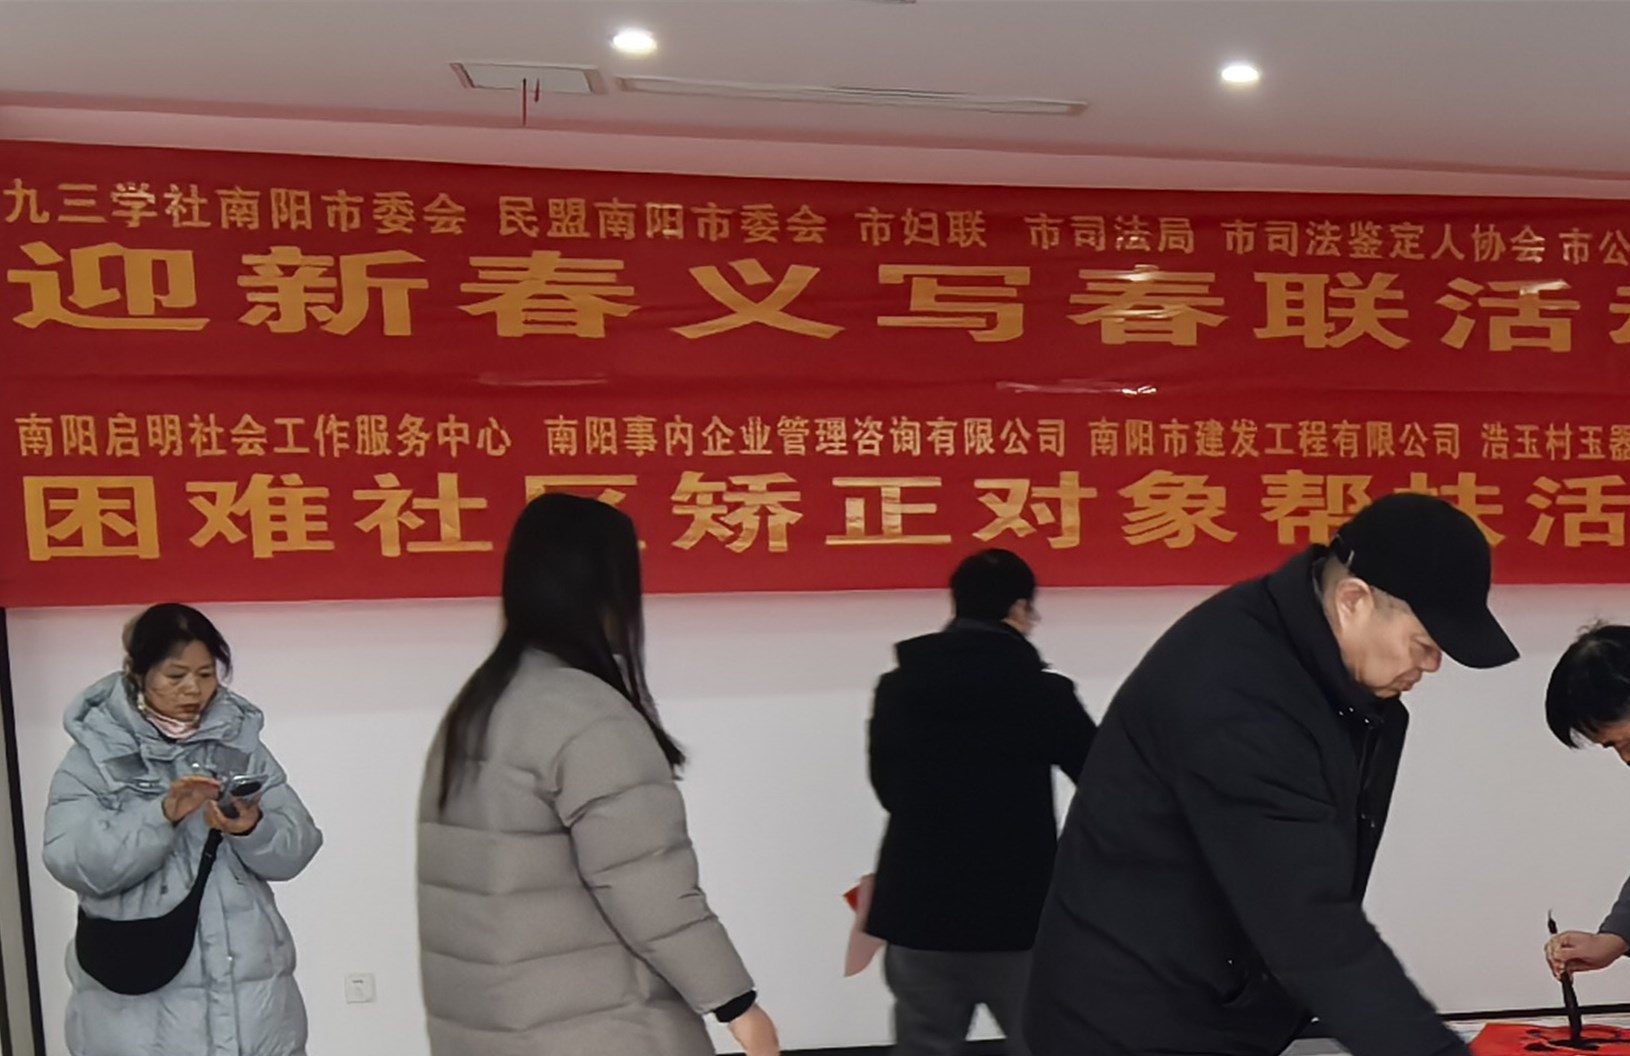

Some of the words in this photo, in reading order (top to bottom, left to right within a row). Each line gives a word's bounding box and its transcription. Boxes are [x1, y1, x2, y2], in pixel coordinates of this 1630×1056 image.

[3, 177, 466, 236] 九三学社南阳市委会
[498, 195, 828, 244] 民盟南阳市委会
[854, 206, 987, 249] 市妇联
[1024, 212, 1195, 254] 市司法局
[1221, 220, 1546, 264] 市司法鉴定人协会
[14, 411, 512, 458] 南阳启明社会工作服务中心
[543, 414, 1067, 459] 南阳事内企业管理咨询有限公司
[1088, 417, 1461, 460] 南阳市建发工程有限公司
